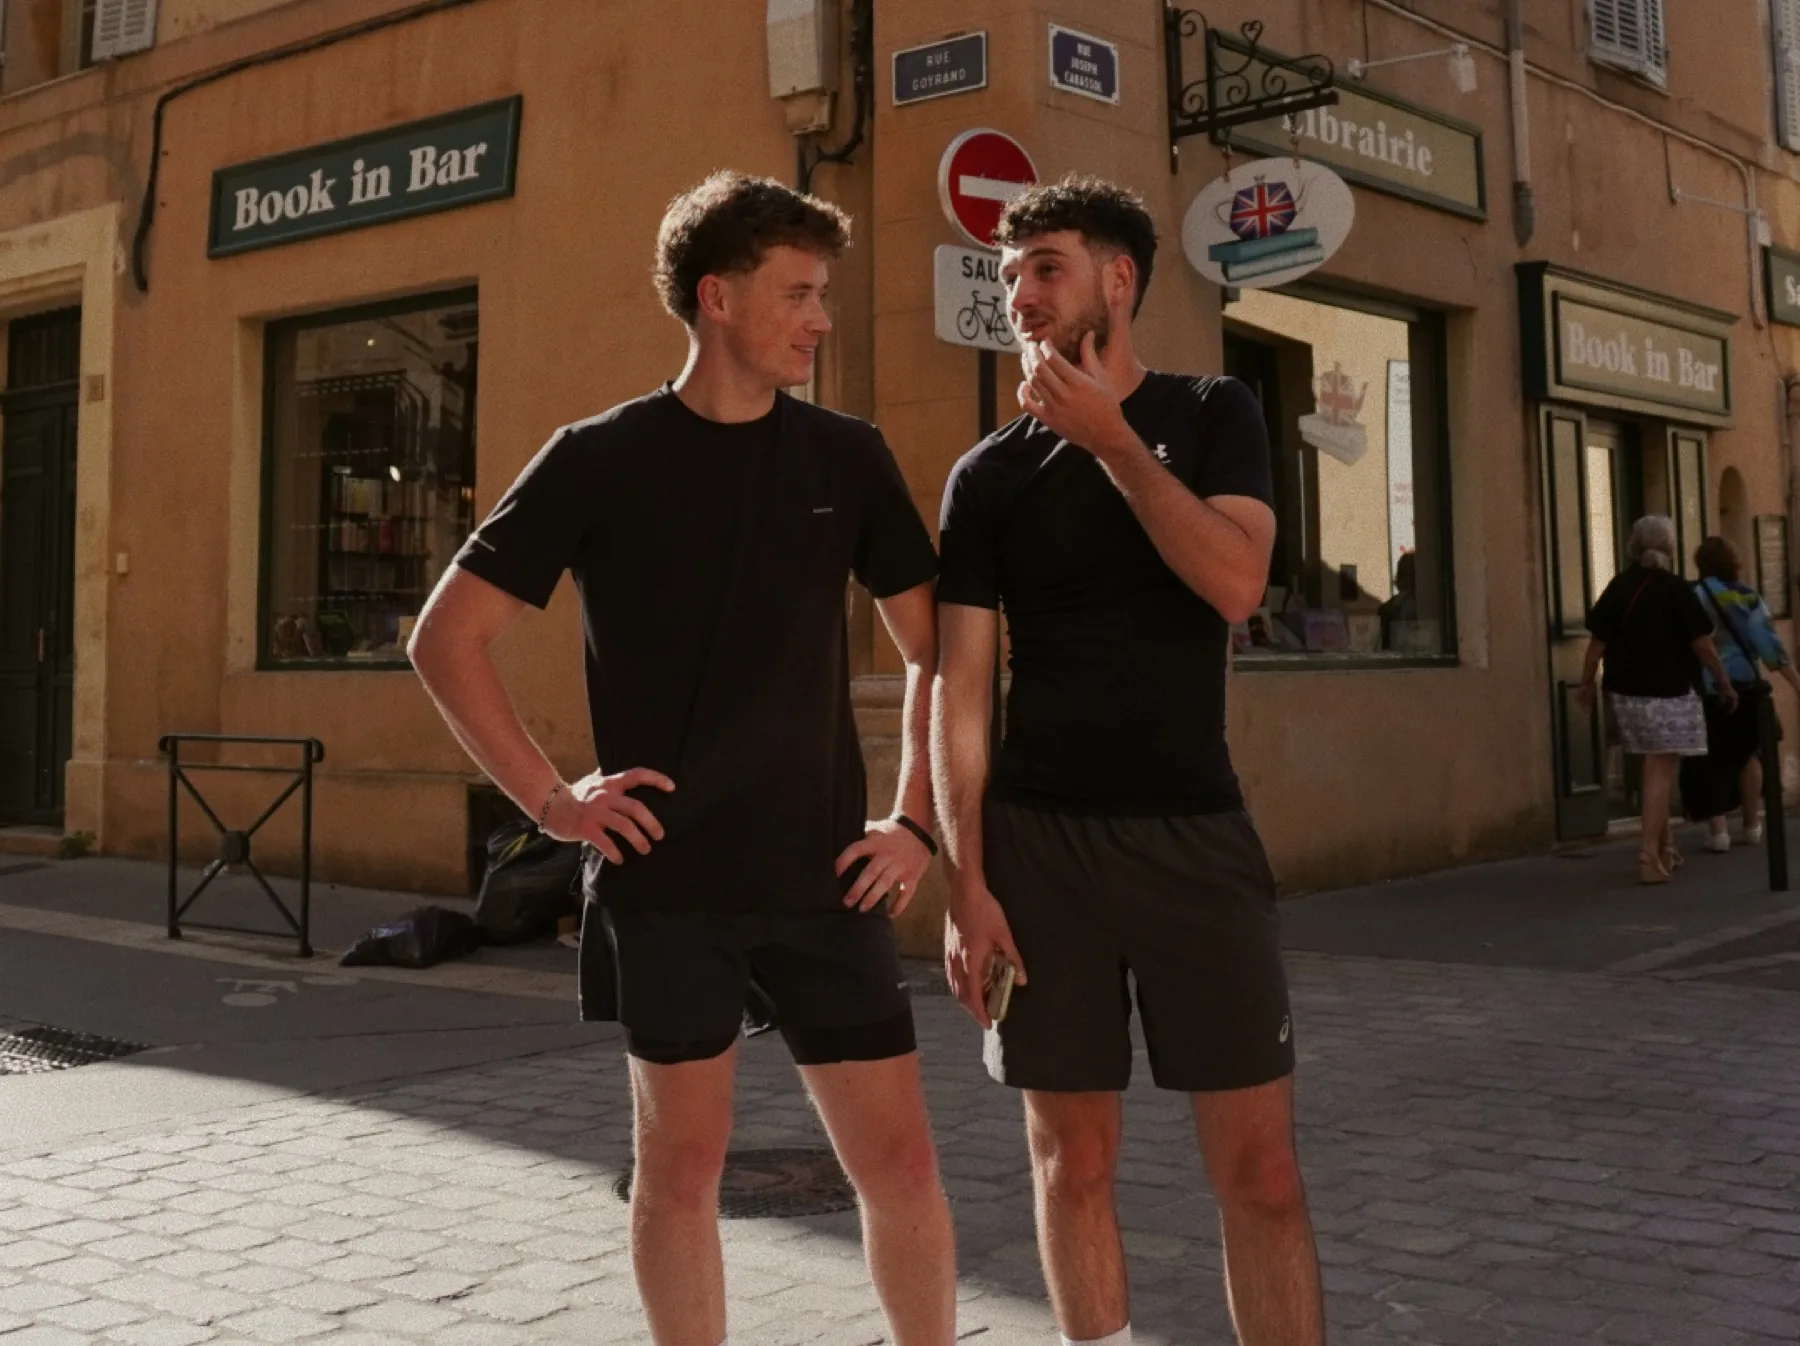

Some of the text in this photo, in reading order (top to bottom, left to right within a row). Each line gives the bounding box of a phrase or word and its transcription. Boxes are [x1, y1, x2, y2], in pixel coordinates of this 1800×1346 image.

[926, 51, 950, 67] RUE
[232, 142, 488, 231] Book in Bar
[962, 255, 999, 283] SAU
[1566, 320, 1718, 392] Book in Bar
